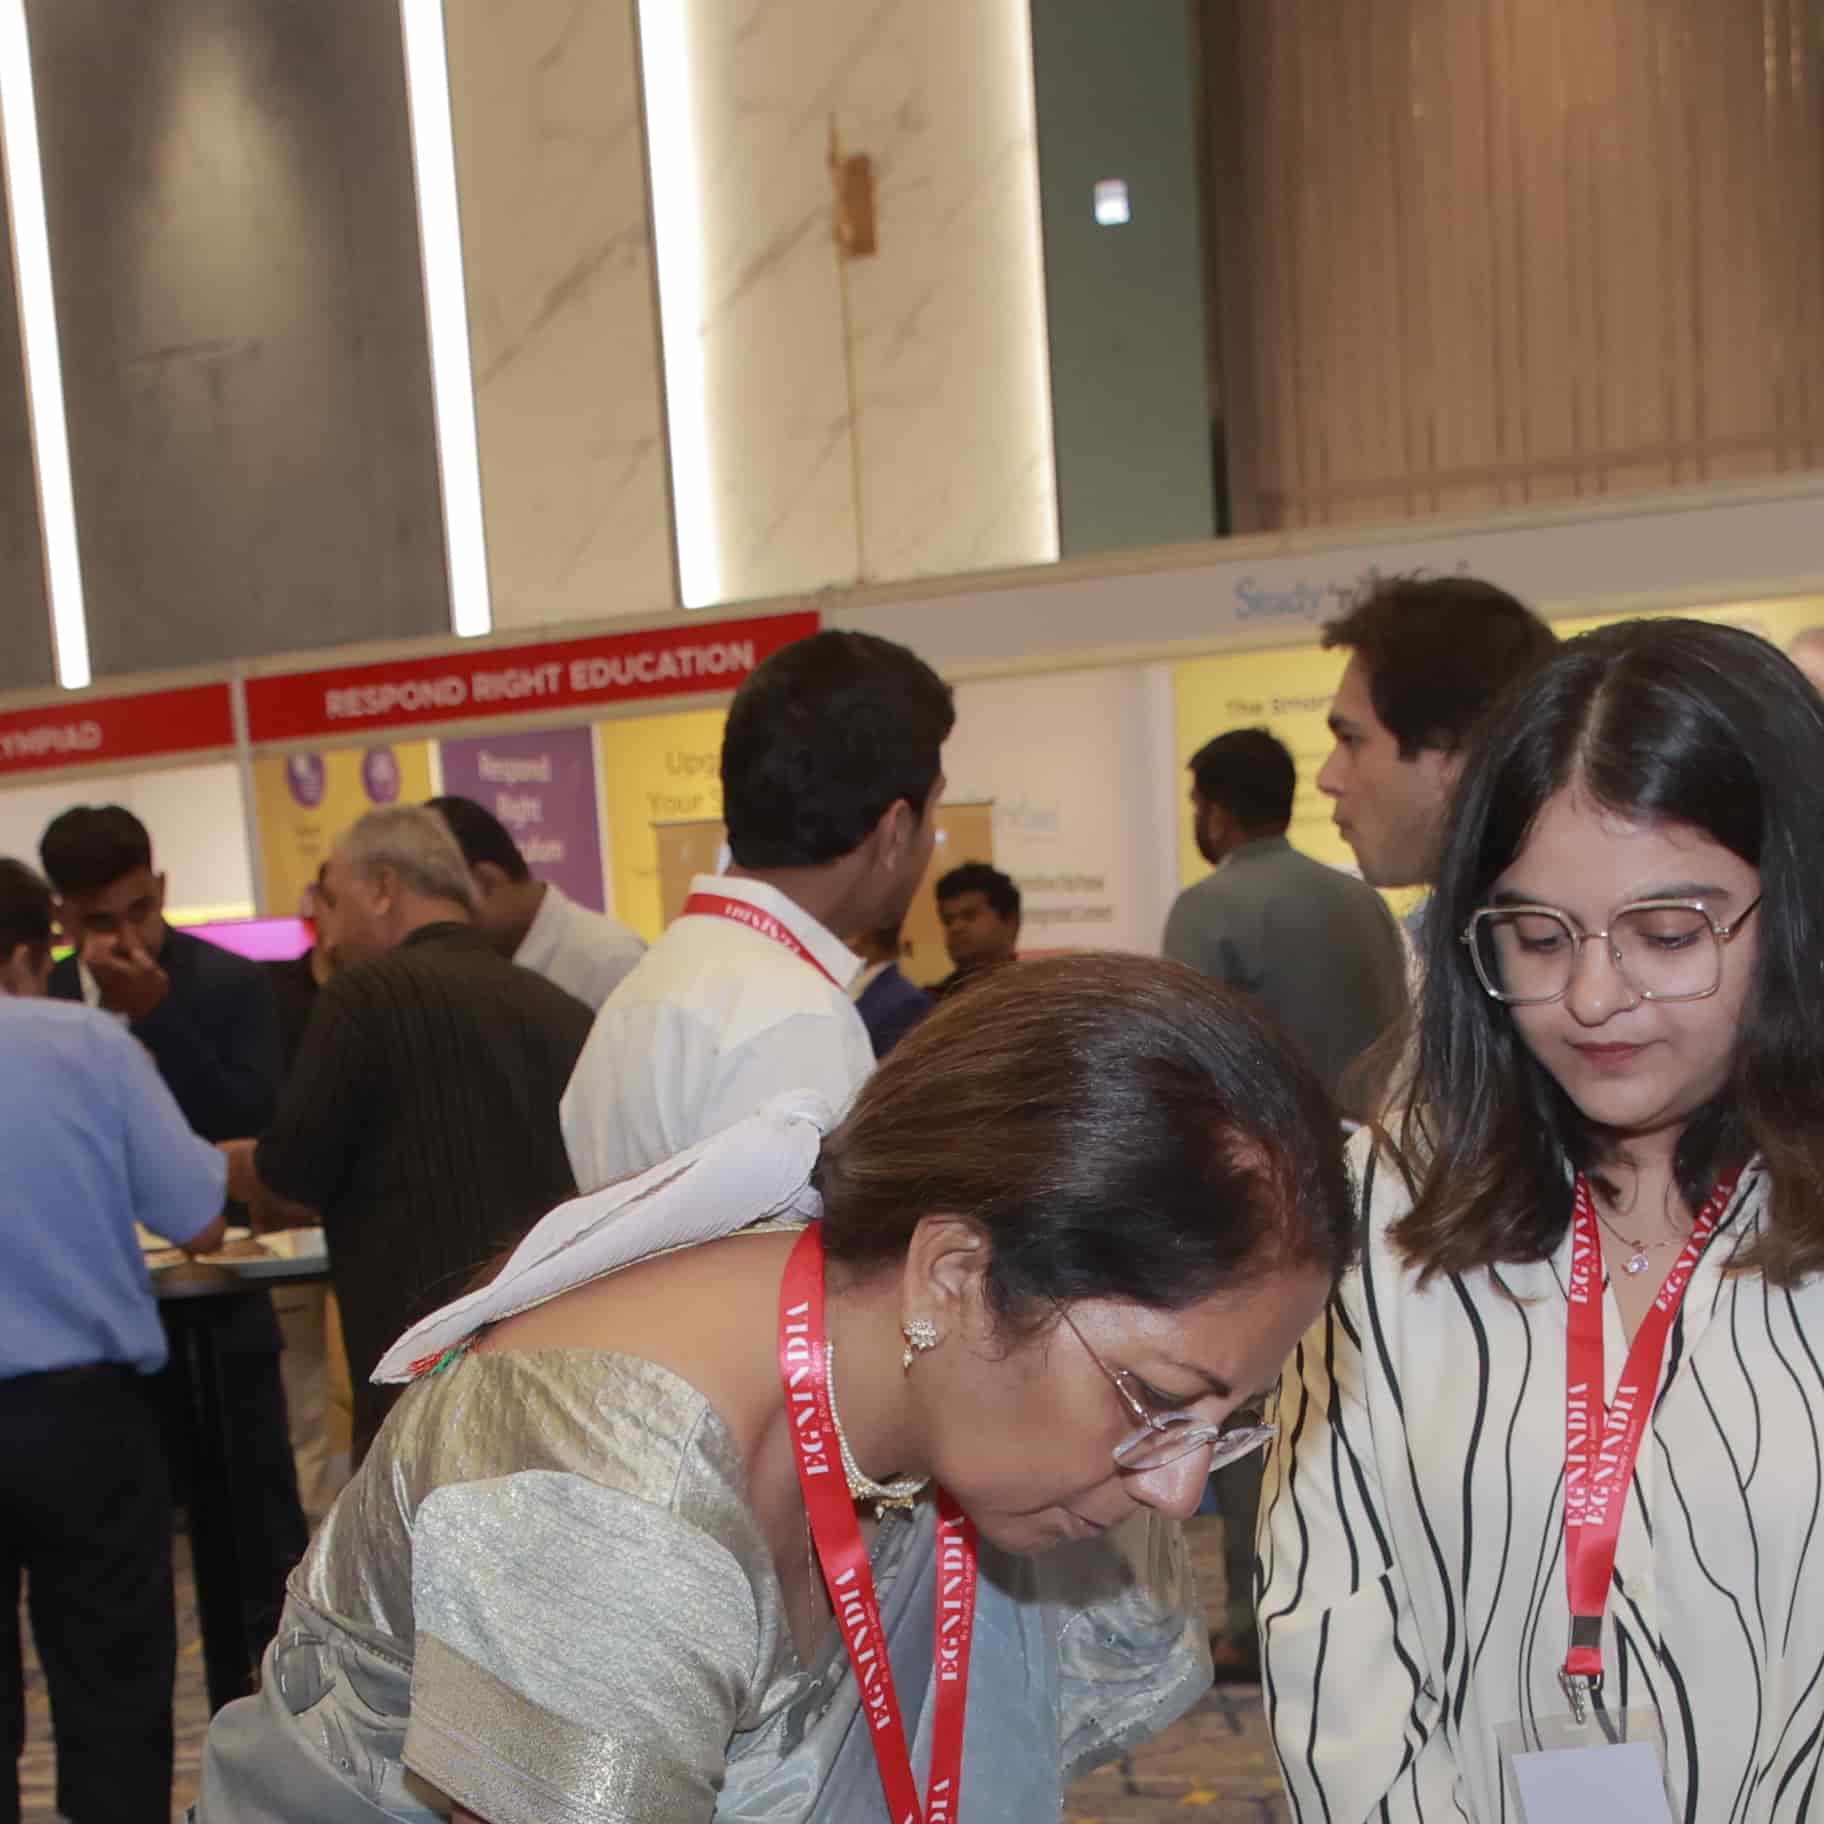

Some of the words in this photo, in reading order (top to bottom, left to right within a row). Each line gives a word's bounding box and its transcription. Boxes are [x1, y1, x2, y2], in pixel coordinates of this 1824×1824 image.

[325, 674, 467, 720] RESPOND
[473, 663, 563, 702] RIGHT
[569, 640, 756, 693] EDUCATION
